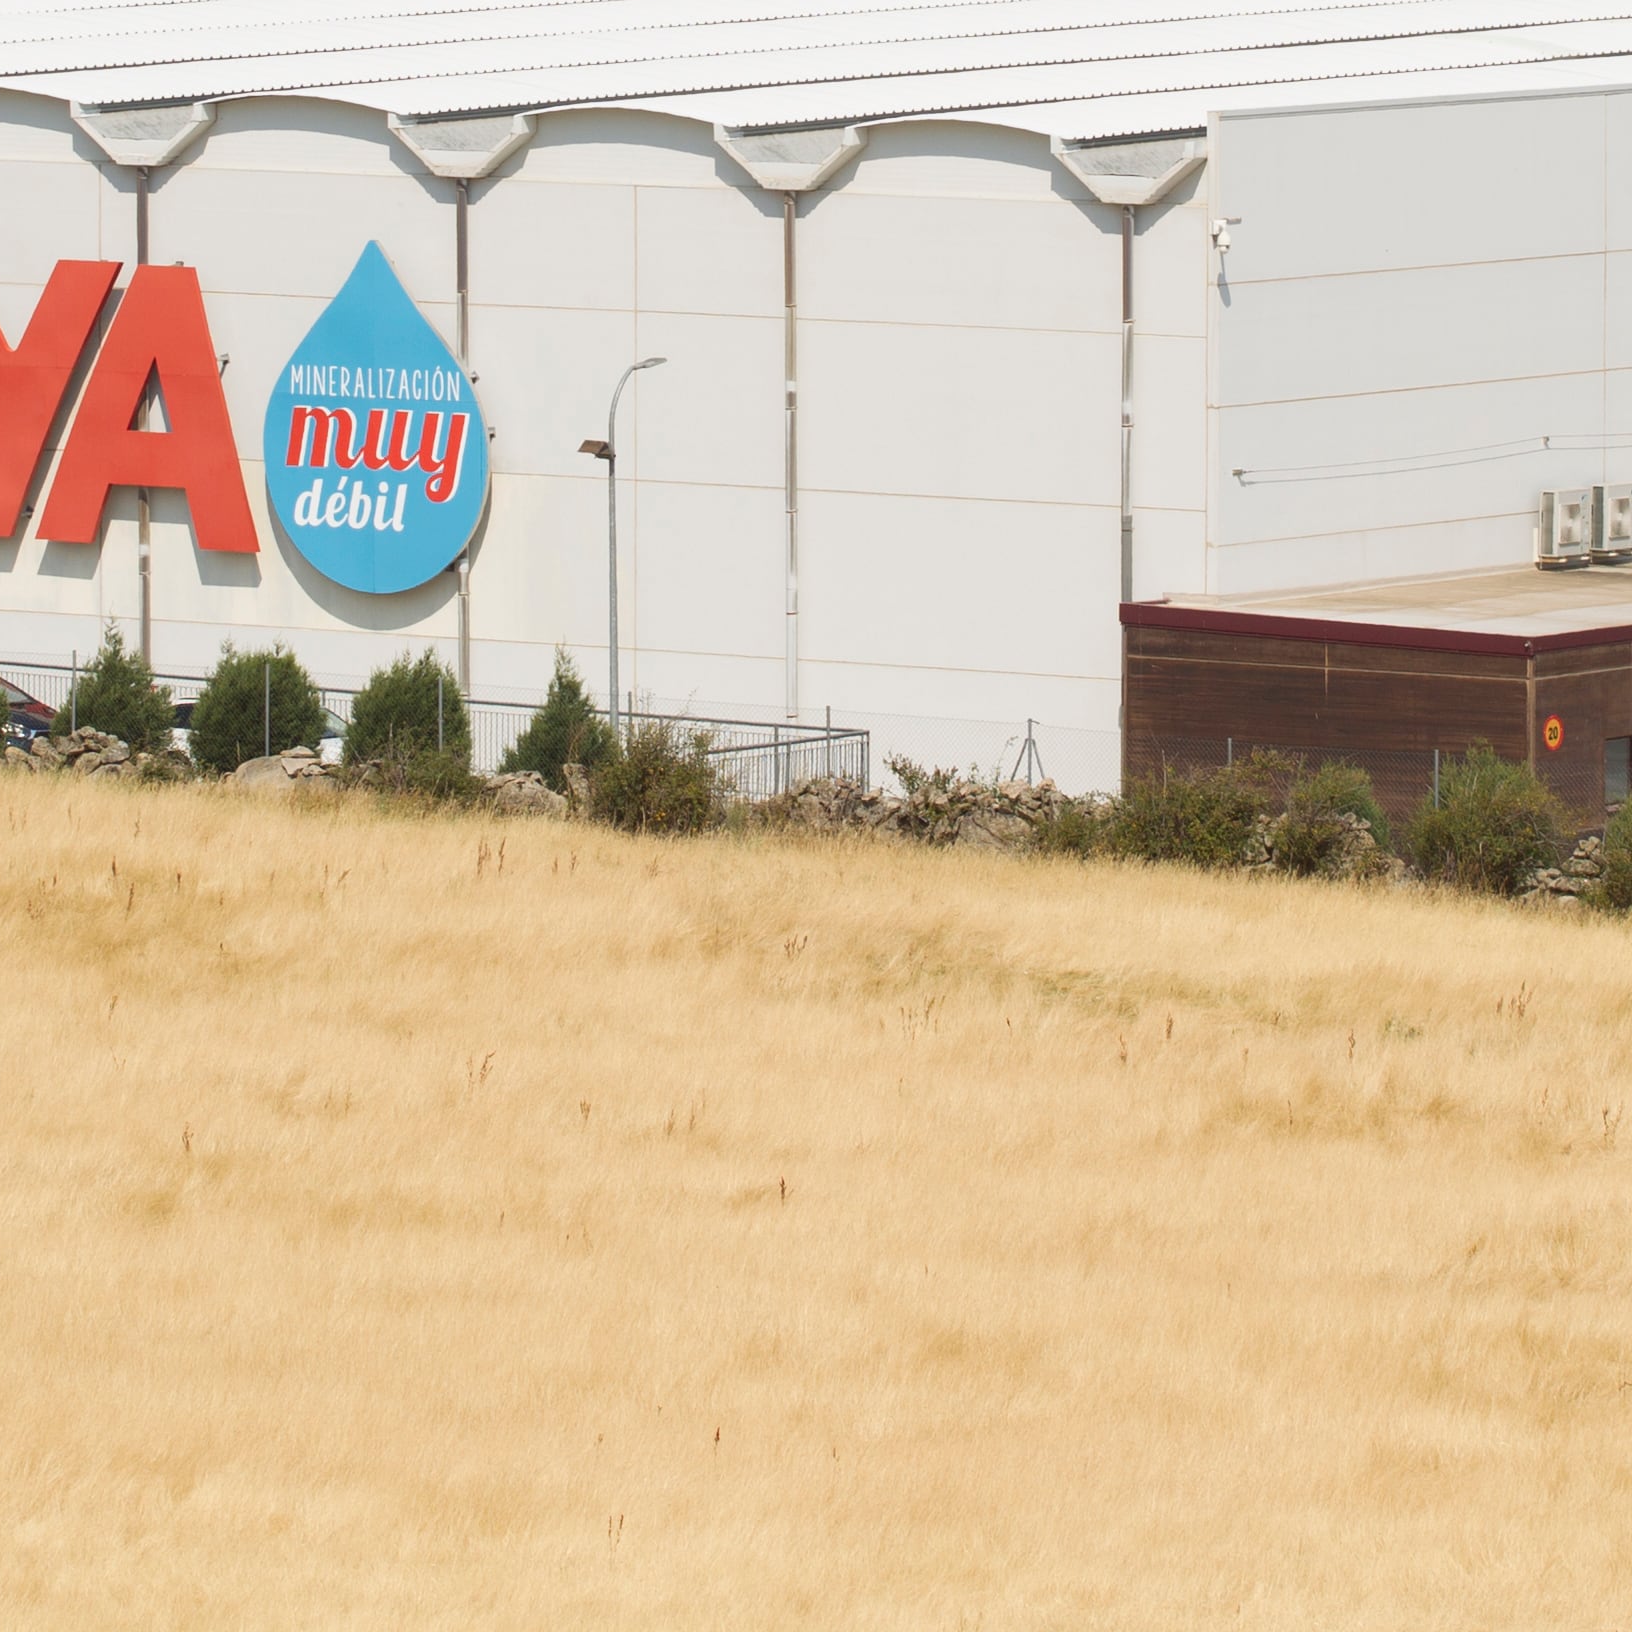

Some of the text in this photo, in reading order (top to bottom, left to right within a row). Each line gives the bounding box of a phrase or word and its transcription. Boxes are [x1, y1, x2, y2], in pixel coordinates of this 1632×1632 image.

[290, 364, 460, 401] MINERALIZACIÓN
[285, 405, 470, 504] muy
[293, 475, 408, 532] débil
[1548, 726, 1558, 741] 20
